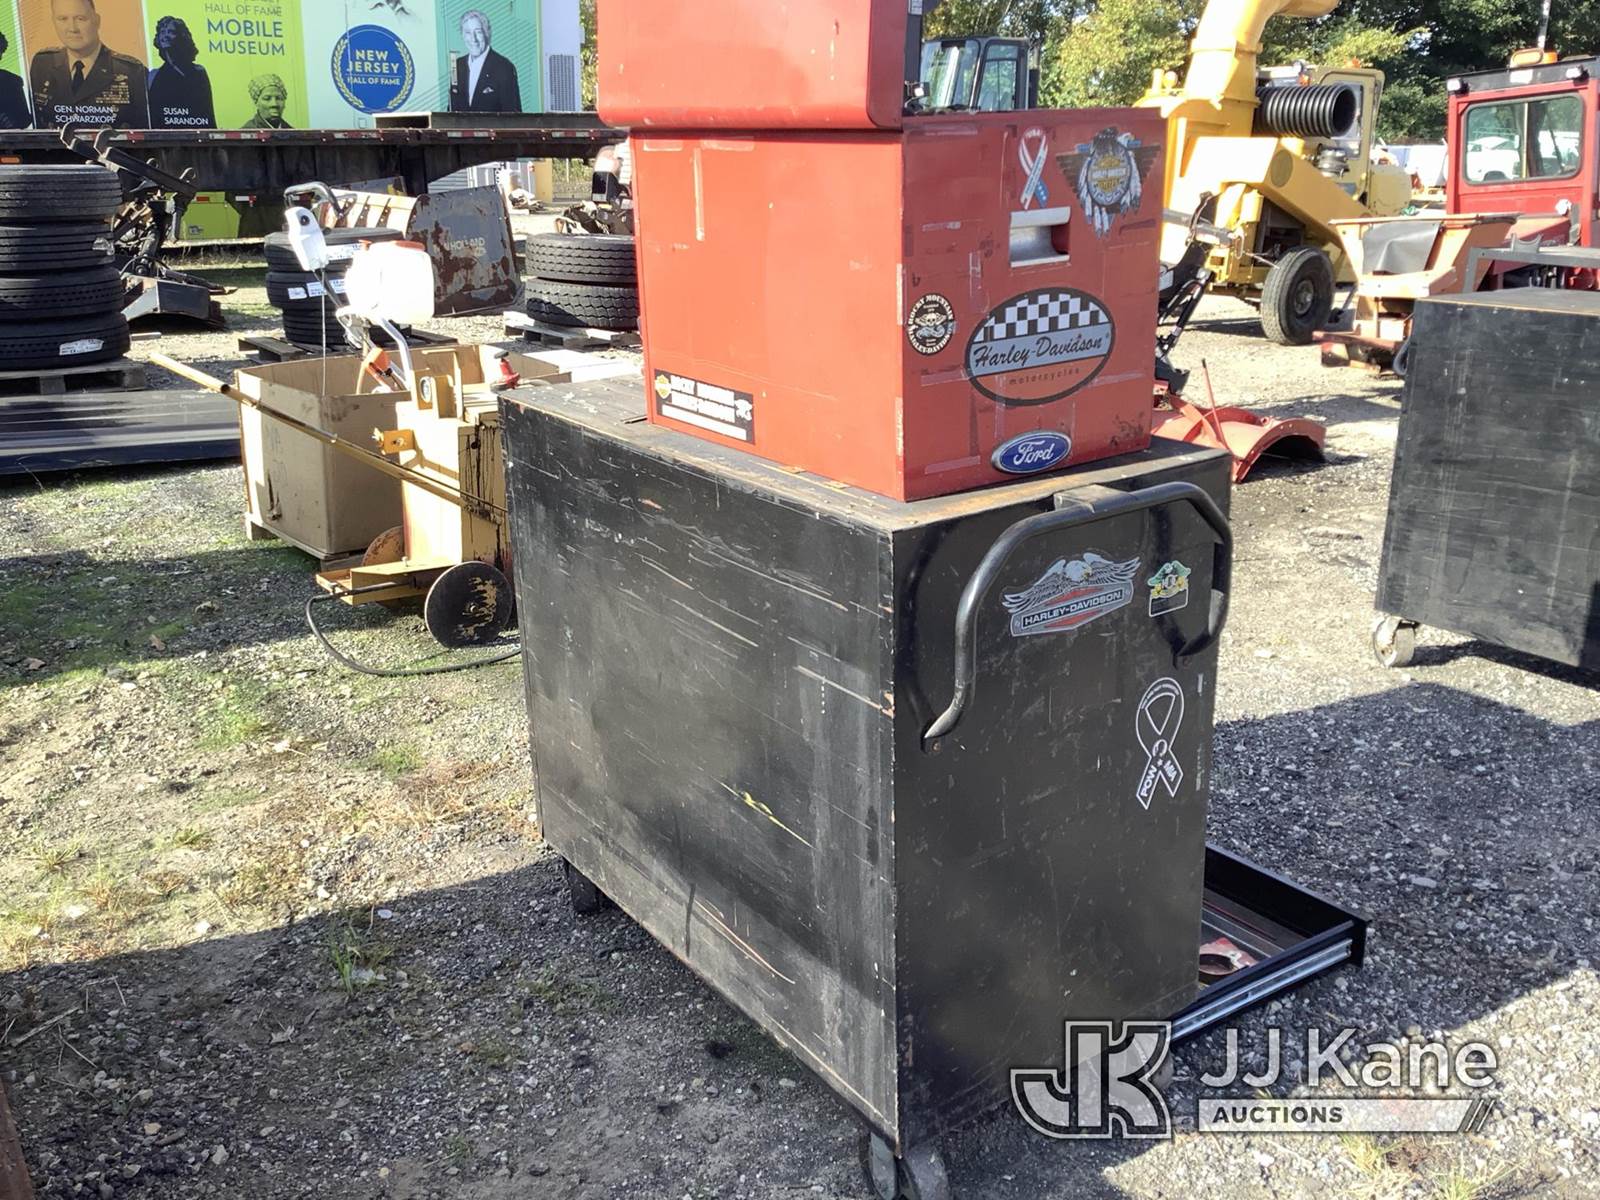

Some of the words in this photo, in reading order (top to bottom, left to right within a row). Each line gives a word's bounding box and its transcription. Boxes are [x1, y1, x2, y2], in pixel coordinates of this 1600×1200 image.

[205, 3, 233, 14] HALL
[235, 5, 251, 15] OF
[254, 6, 283, 16] FAME
[207, 18, 284, 38] MOBILE
[208, 39, 285, 56] MUSEUM
[355, 49, 389, 61] NEW
[346, 60, 400, 74] JERSEY
[347, 76, 367, 84] HALL
[367, 77, 380, 85] OF
[380, 78, 401, 86] FAME
[75, 105, 114, 114] NORMAN
[163, 107, 189, 116] SUSAN
[55, 114, 117, 123] SCHWARZKOPF
[164, 116, 209, 125] SARANDON
[973, 335, 1103, 368] Harley-Davidson
[1013, 439, 1056, 466] Ford
[1024, 590, 1122, 626] HARLEY-DAVIDSON
[1140, 764, 1158, 797] POW
